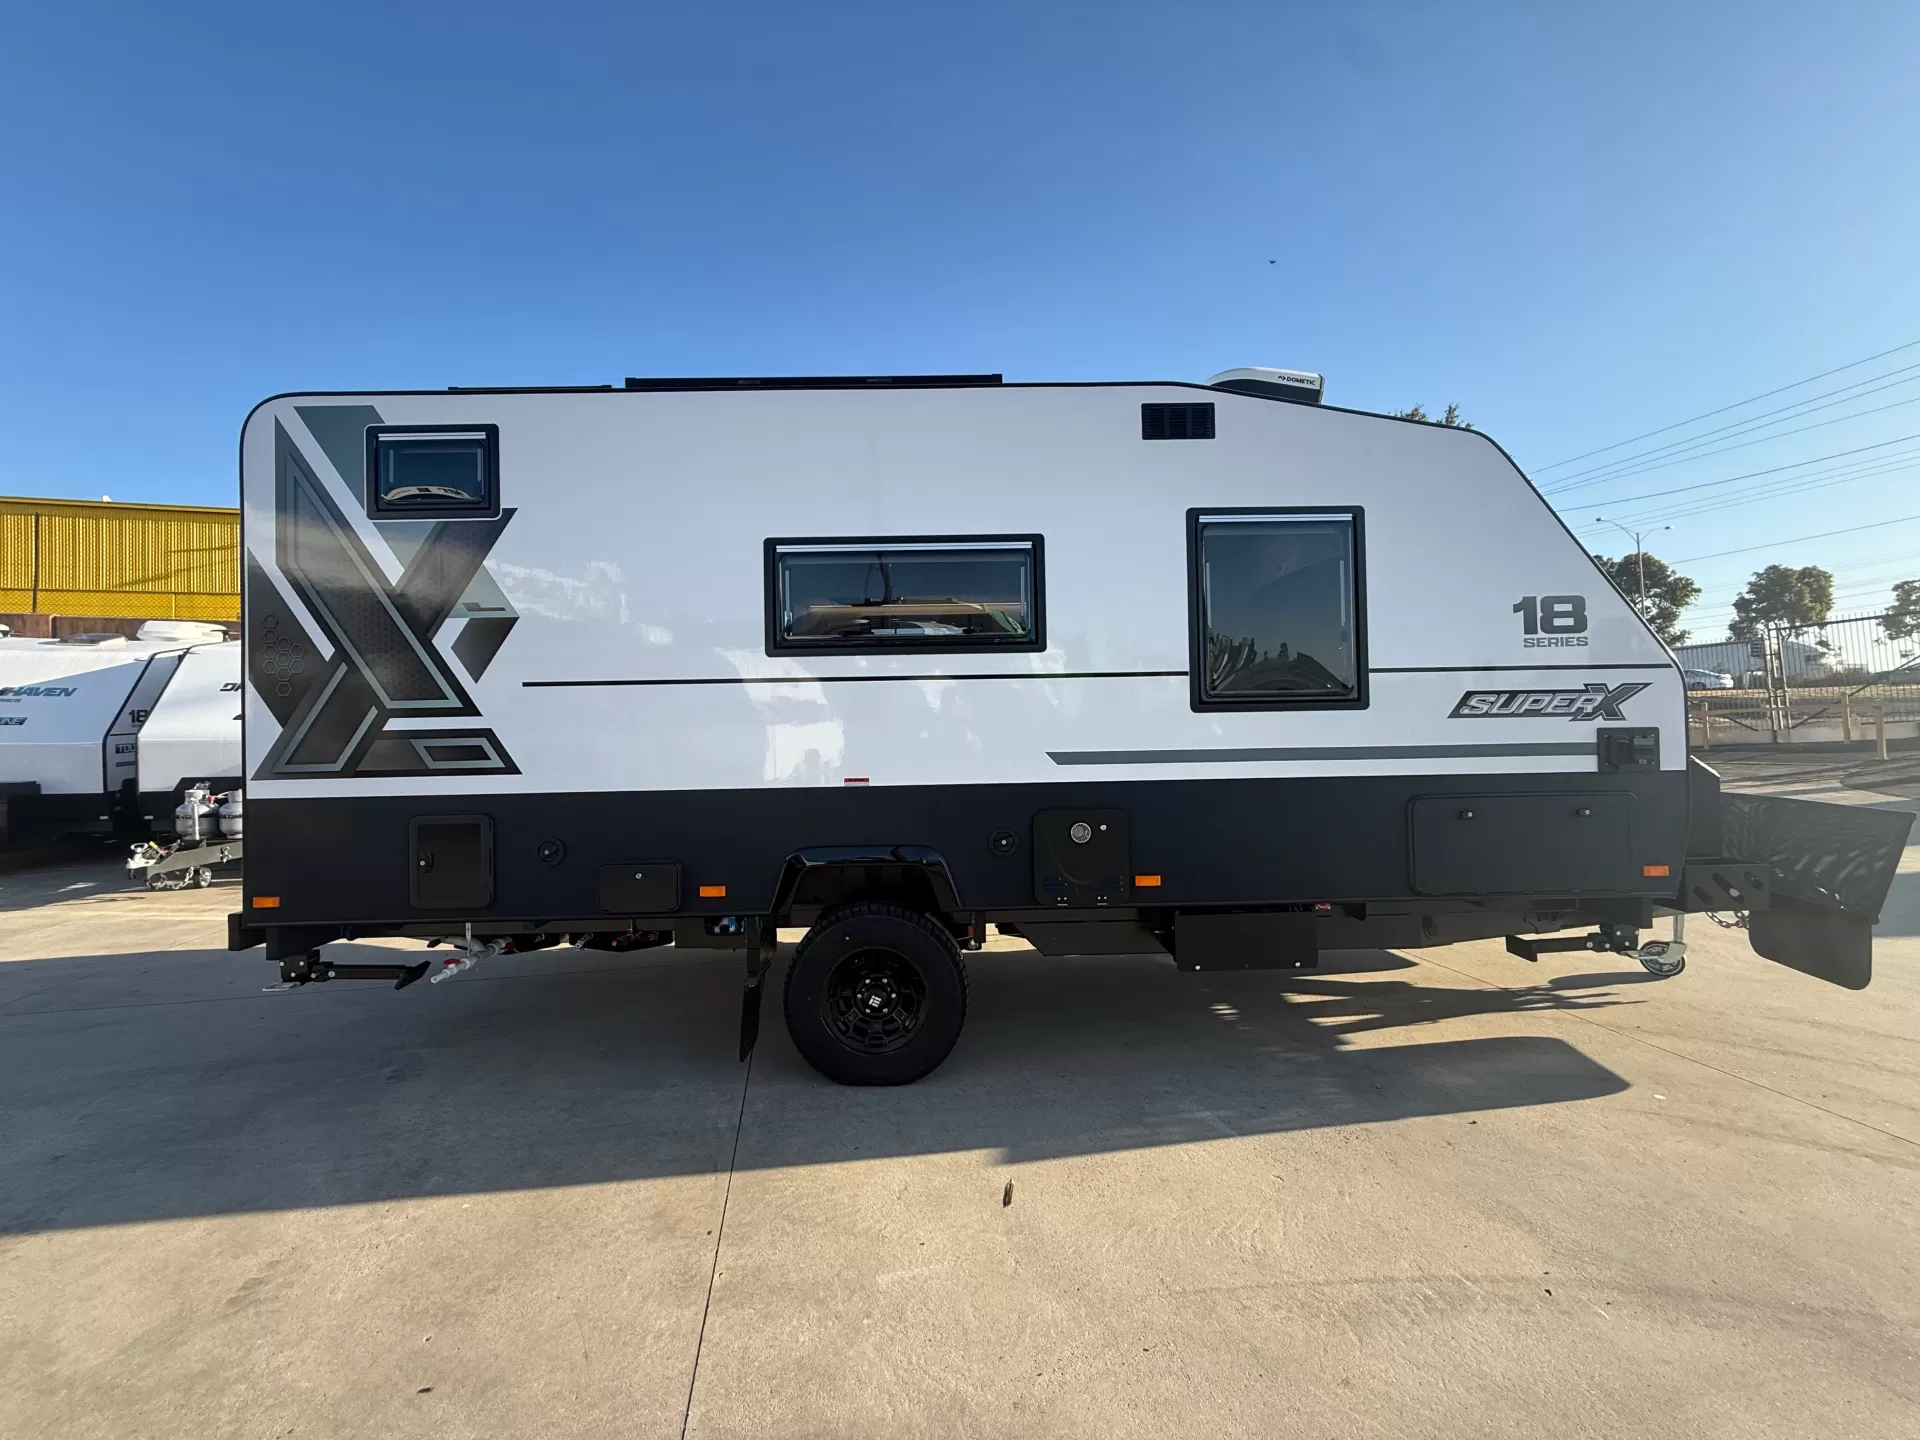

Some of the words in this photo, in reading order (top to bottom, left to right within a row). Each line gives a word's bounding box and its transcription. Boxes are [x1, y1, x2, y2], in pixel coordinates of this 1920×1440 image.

[1286, 376, 1316, 386] DOMETIC
[1512, 594, 1588, 635] 18
[1523, 636, 1589, 648] SERIES
